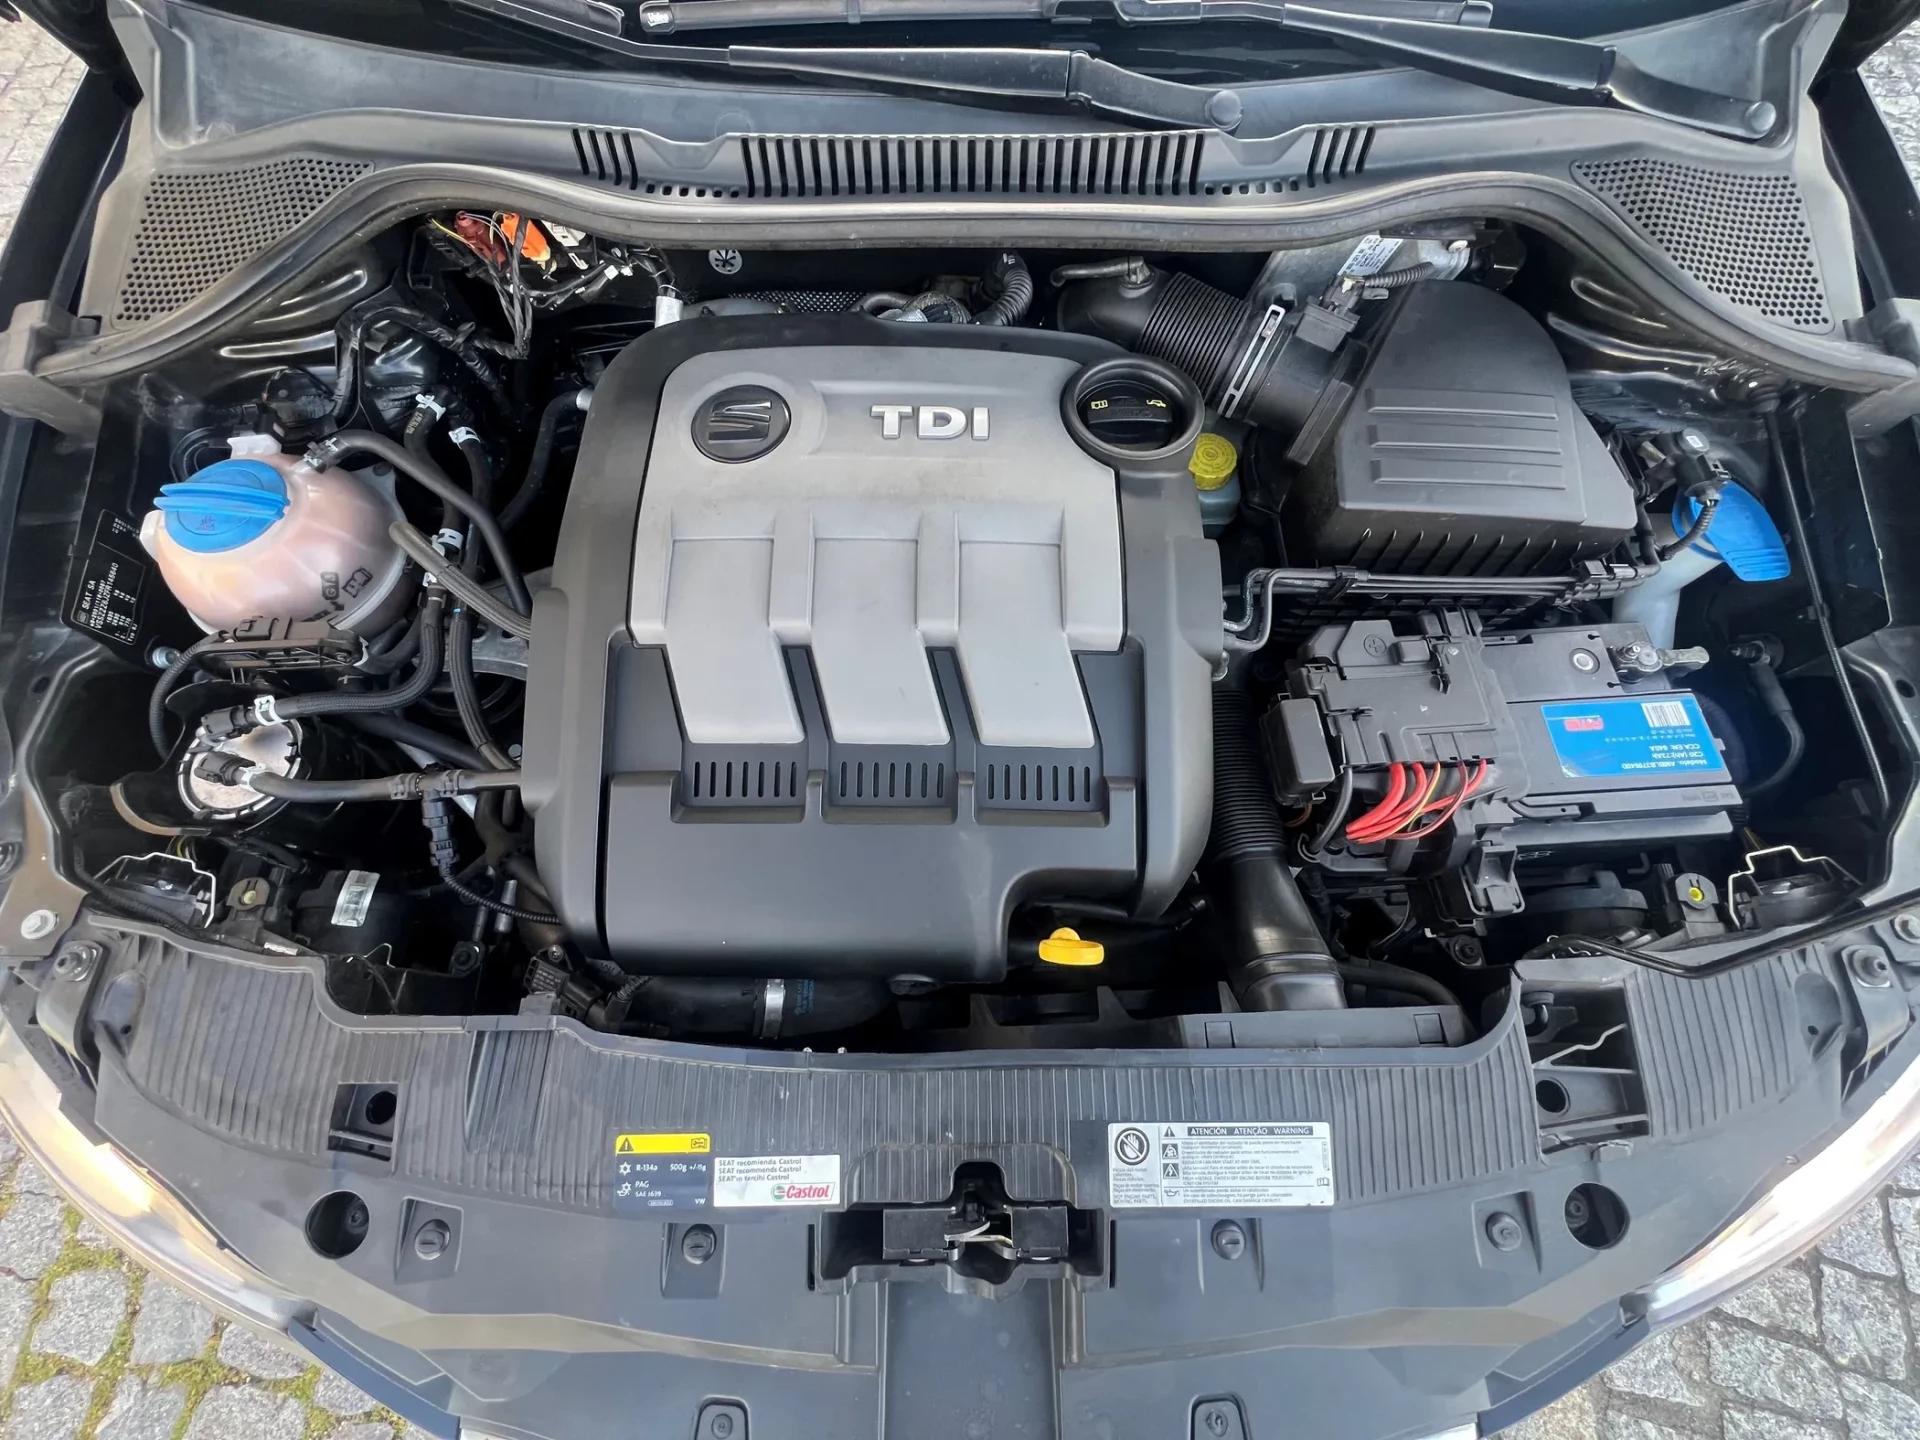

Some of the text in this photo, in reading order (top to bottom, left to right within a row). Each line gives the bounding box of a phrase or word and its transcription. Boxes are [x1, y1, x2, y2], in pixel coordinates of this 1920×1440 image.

[870, 405, 990, 440] TDI
[81, 580, 96, 610] SEAT SA
[1190, 1126, 1310, 1136] ATENCIÓN ATENÇÃO WARNING
[719, 1159, 735, 1167] SEAT
[736, 1159, 777, 1167] recomienda
[636, 1163, 658, 1172] R-134a
[670, 1163, 687, 1174] 500g
[718, 1167, 735, 1175] SEAT
[736, 1167, 777, 1175] recommends
[635, 1180, 650, 1189] PAG
[785, 1185, 830, 1200] Castrol
